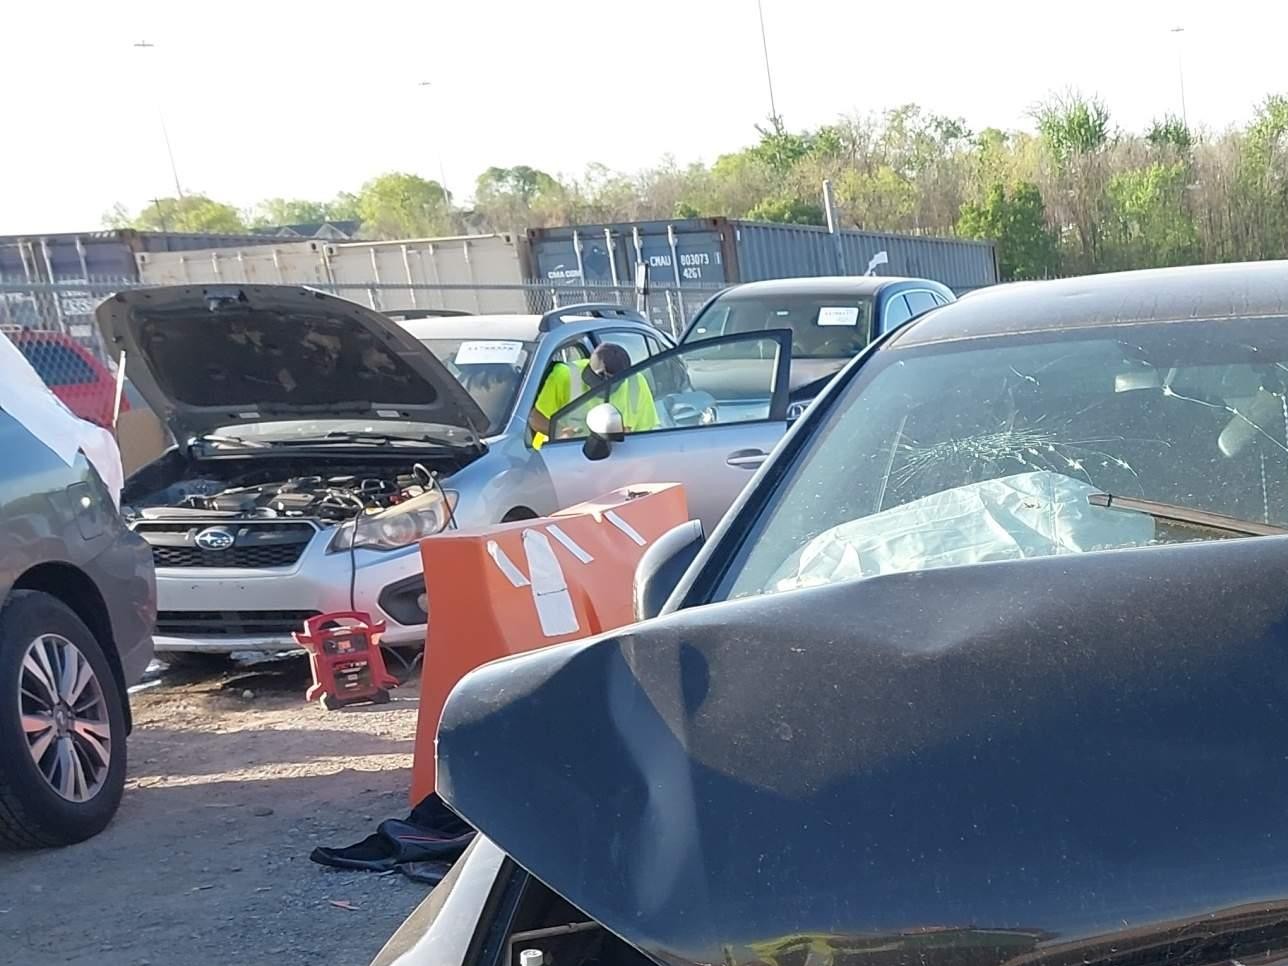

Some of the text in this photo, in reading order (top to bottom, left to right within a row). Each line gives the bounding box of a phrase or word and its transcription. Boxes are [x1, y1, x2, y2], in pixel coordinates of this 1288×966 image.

[650, 255, 672, 267] CMAU
[680, 253, 709, 266] 803073
[683, 267, 702, 279] 4261
